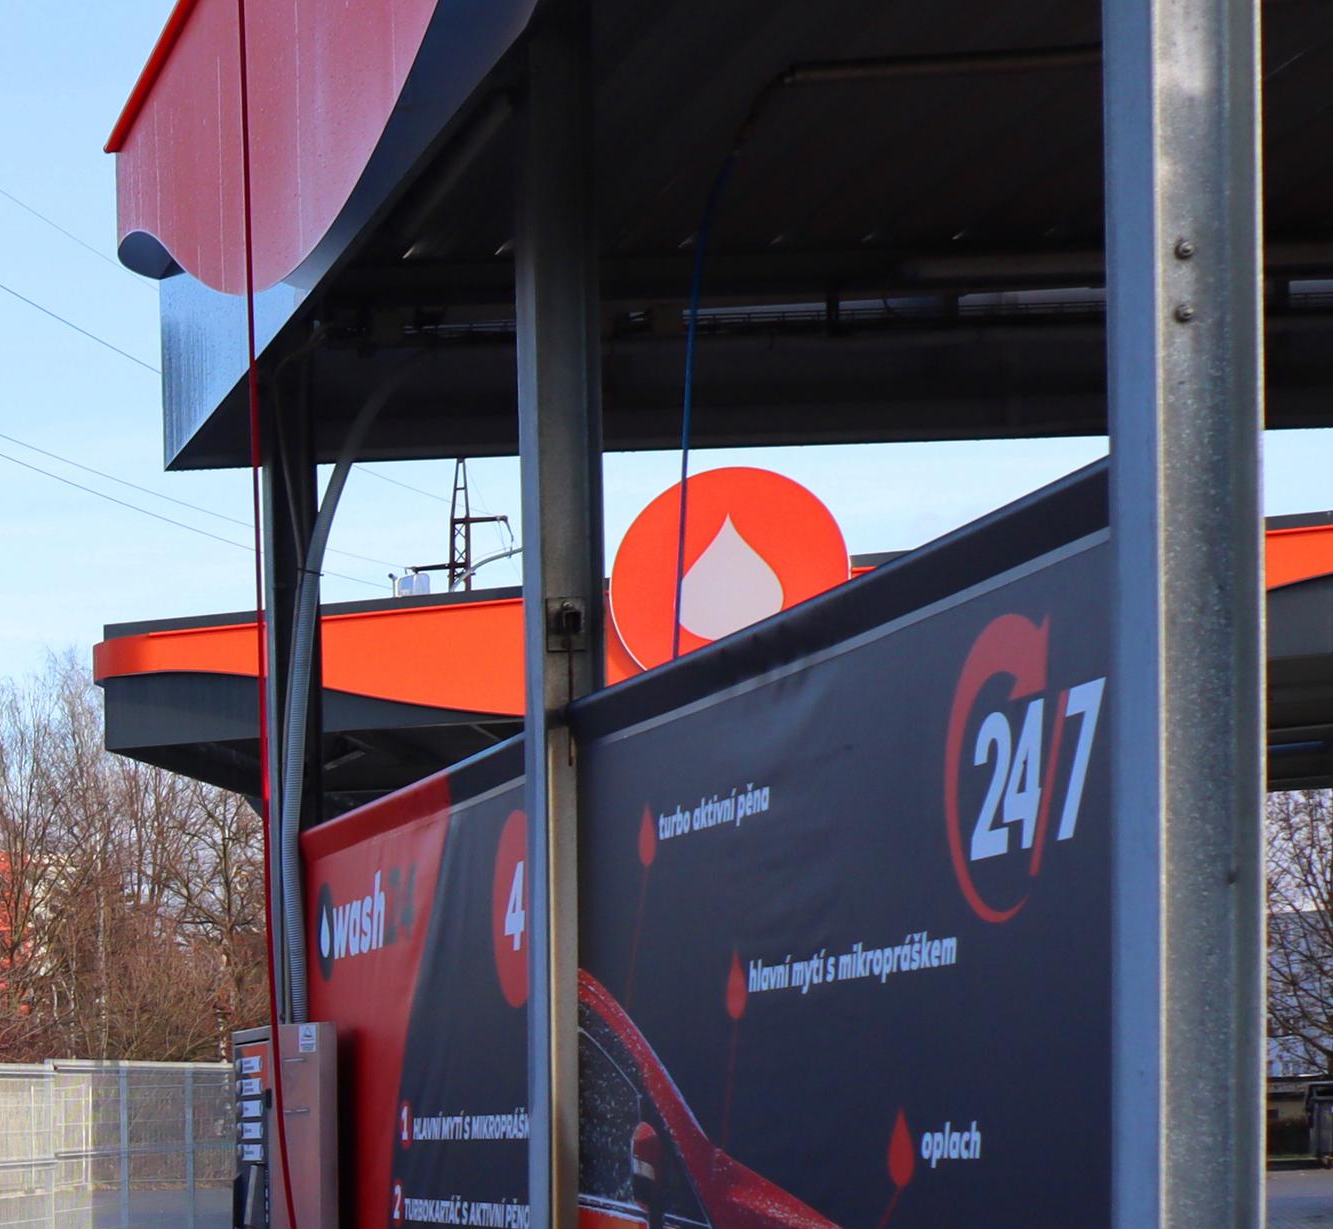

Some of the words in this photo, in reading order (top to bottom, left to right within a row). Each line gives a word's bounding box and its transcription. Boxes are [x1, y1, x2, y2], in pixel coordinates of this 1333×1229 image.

[970, 676, 1107, 877] 24/7
[658, 804, 691, 841] turbo
[692, 788, 737, 831] aktivní
[735, 782, 770, 827] pěna
[504, 860, 526, 951] 4
[747, 954, 791, 993] hlavní
[790, 948, 826, 995] mytí
[825, 956, 836, 983] s
[837, 930, 958, 984] mikropráškem
[401, 1105, 409, 1141] 1
[412, 1111, 442, 1141] HLAVNÍ
[441, 1110, 464, 1140] MYTÍ
[463, 1114, 471, 1140] S
[921, 1120, 982, 1169] oplach
[393, 1184, 402, 1220] 2
[403, 1194, 461, 1225] TURBOKARTÁČ
[461, 1201, 469, 1226] S
[469, 1197, 506, 1229] AKTIVNÍ
